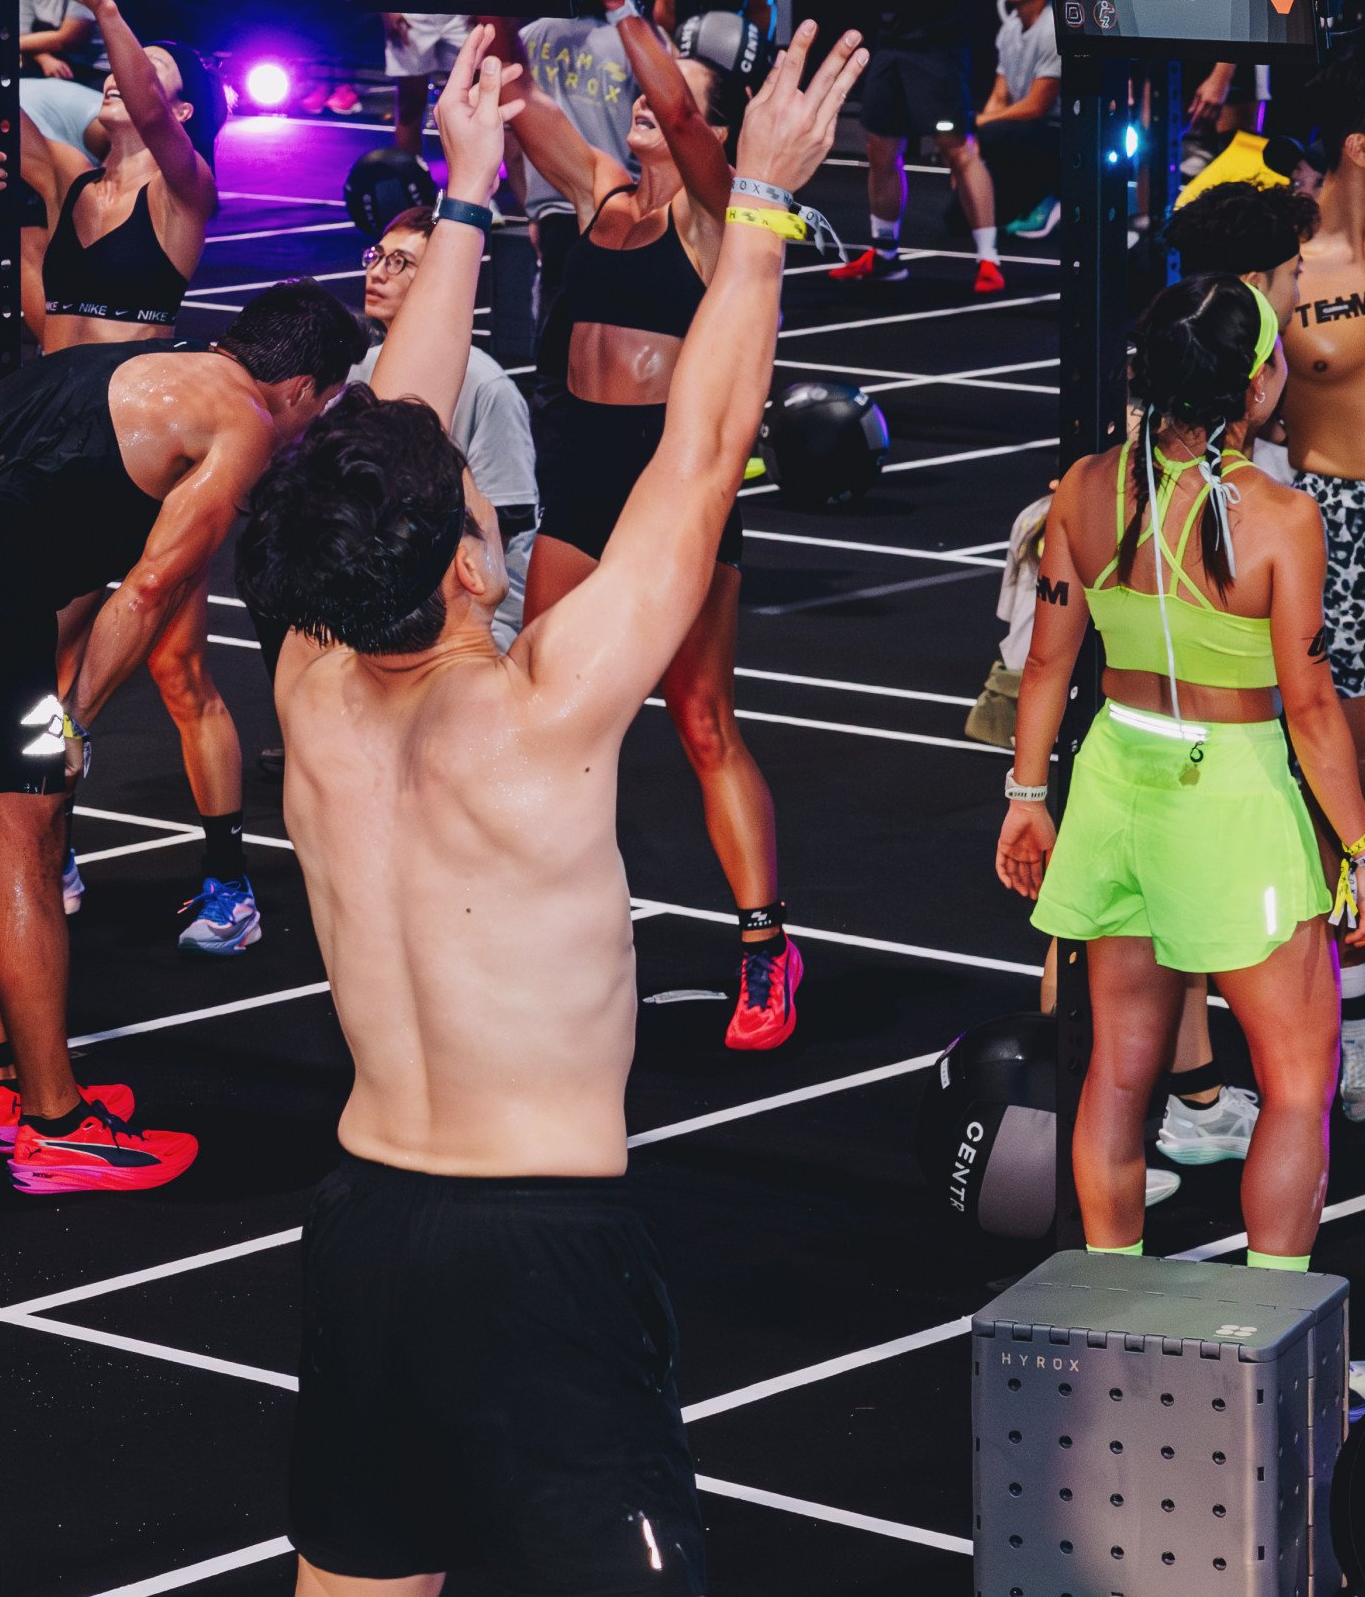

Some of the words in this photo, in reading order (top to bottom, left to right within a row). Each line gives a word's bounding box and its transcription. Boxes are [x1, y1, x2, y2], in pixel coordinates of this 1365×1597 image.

[79, 302, 107, 316] NIKE
[137, 309, 168, 322] NIKE
[949, 1121, 984, 1212] CENTR
[1001, 1352, 1080, 1372] HYROX
